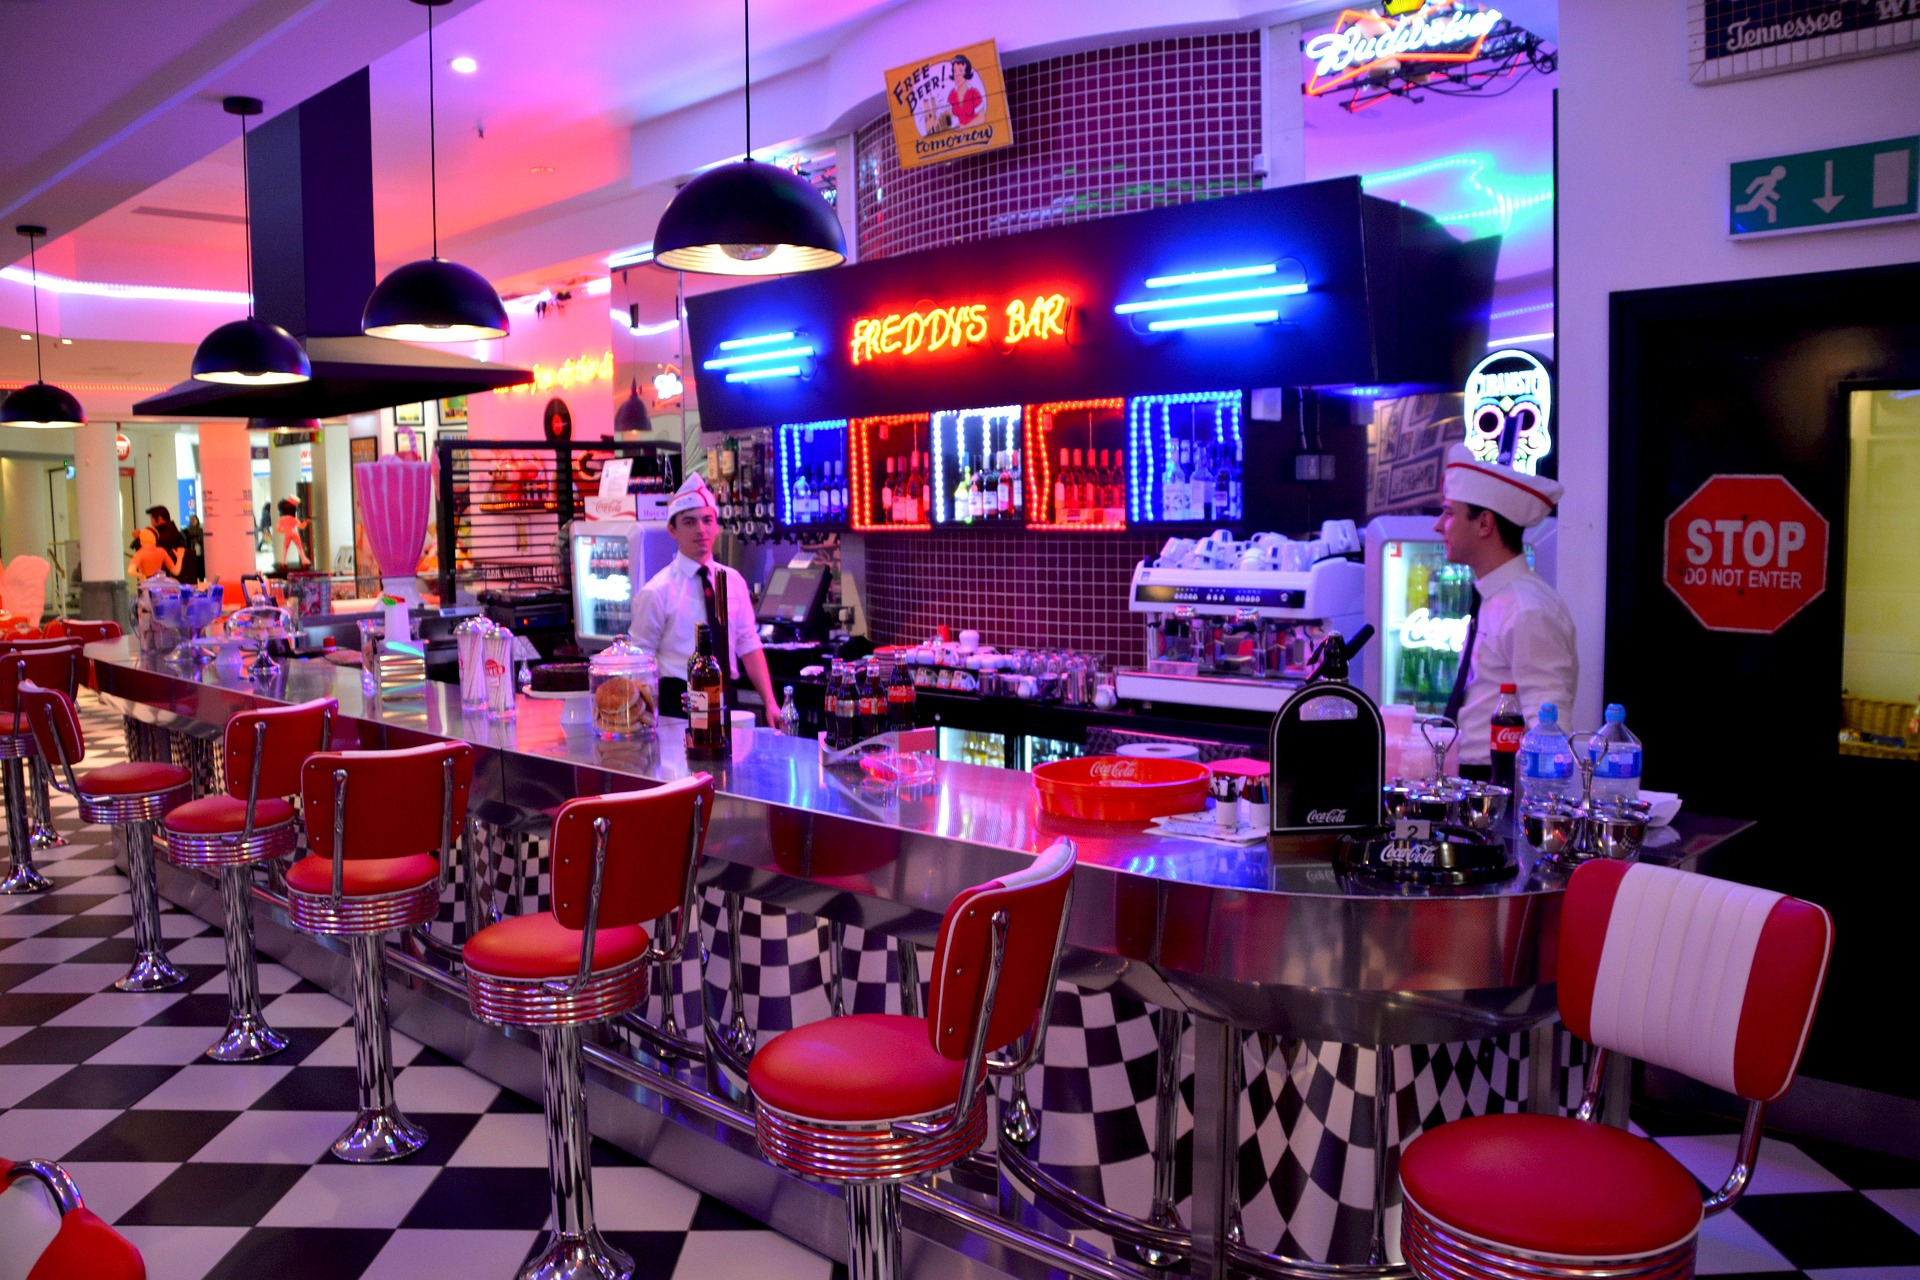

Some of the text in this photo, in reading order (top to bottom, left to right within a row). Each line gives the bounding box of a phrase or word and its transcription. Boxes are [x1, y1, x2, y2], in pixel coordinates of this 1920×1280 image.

[1306, 8, 1503, 77] Budweiser
[1726, 10, 1843, 51] Tennessee
[893, 63, 930, 106] FREE
[905, 65, 946, 116] BEER!
[915, 124, 994, 154] tomorrow
[851, 293, 1066, 365] FREDDY'S BAR
[1685, 518, 1807, 568] STOP
[1684, 567, 1802, 589] DO NOT ENTER
[1407, 825, 1419, 839] 2
